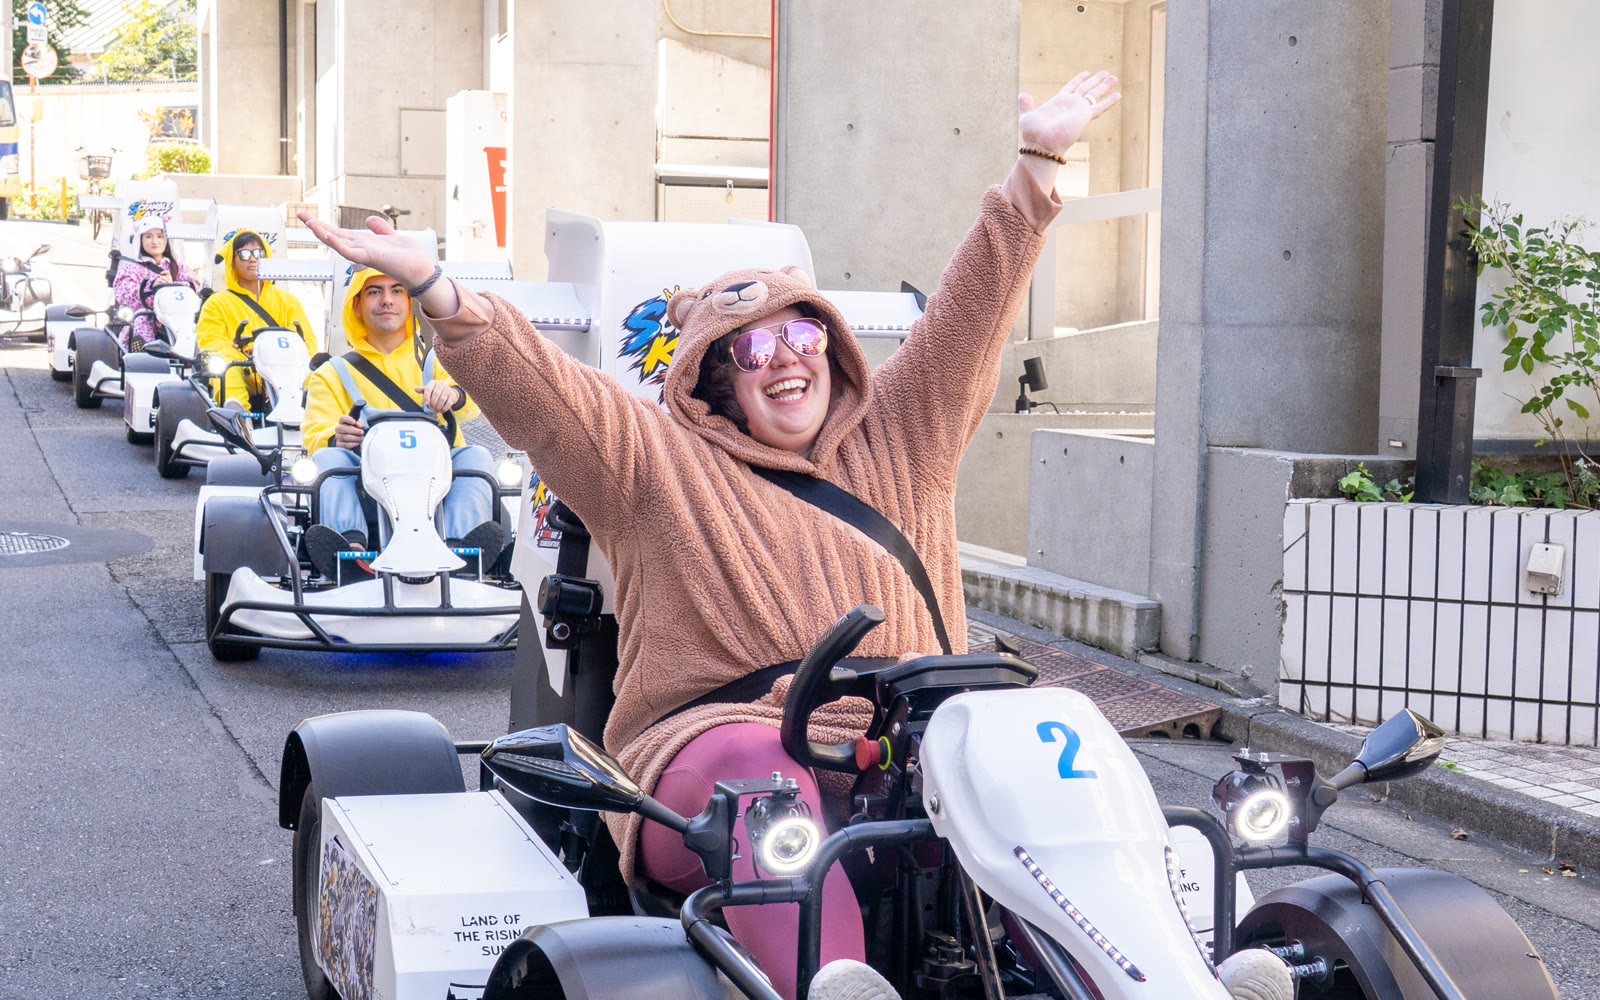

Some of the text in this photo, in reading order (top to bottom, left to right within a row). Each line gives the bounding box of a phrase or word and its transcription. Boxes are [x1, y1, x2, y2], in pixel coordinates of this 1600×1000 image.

[174, 291, 185, 301] 3
[277, 336, 290, 349] 6
[399, 430, 417, 449] 5
[1036, 721, 1098, 779] 2
[461, 914, 521, 927] LAND OF
[453, 929, 522, 942] THE RISIN
